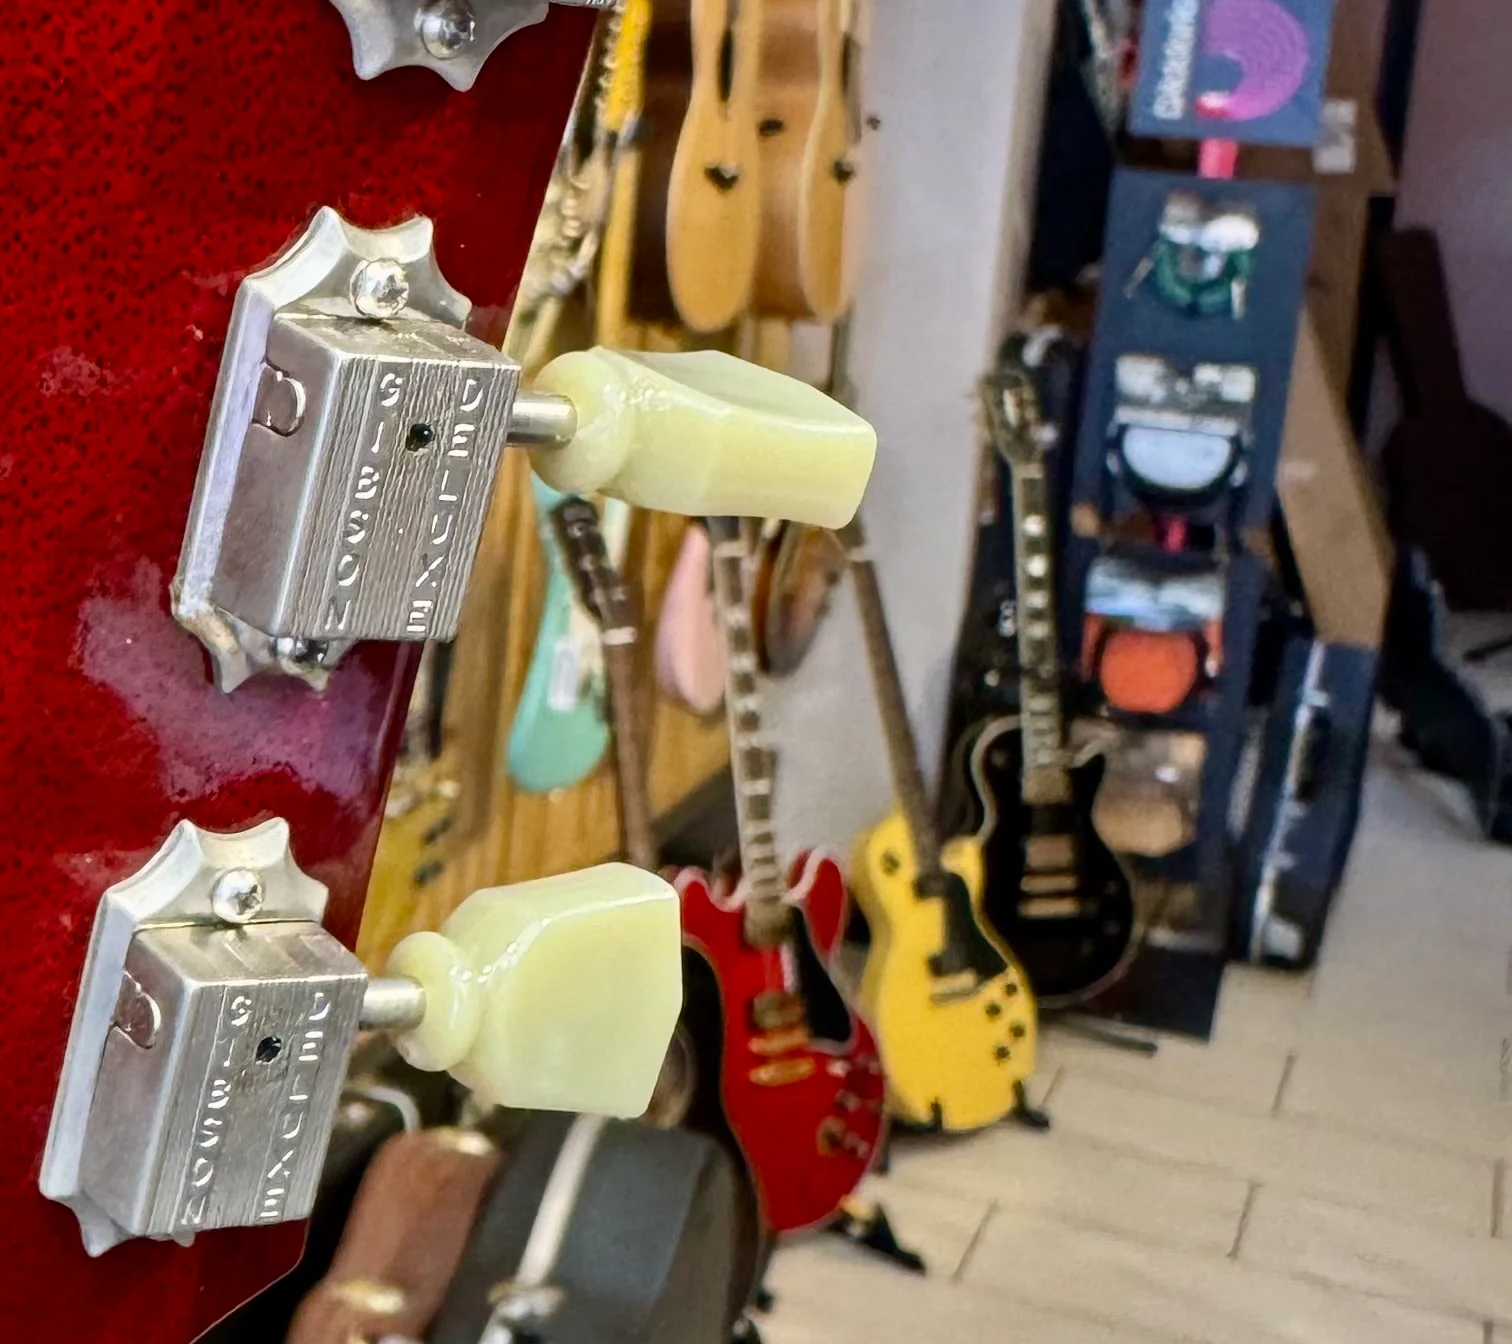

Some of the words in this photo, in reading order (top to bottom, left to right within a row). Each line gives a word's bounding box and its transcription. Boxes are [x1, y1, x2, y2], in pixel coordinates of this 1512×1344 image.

[325, 372, 403, 632] GIBSON
[406, 378, 484, 633] DELUXE
[181, 995, 253, 1226] GIBSON
[259, 992, 331, 1218] DELUXE
